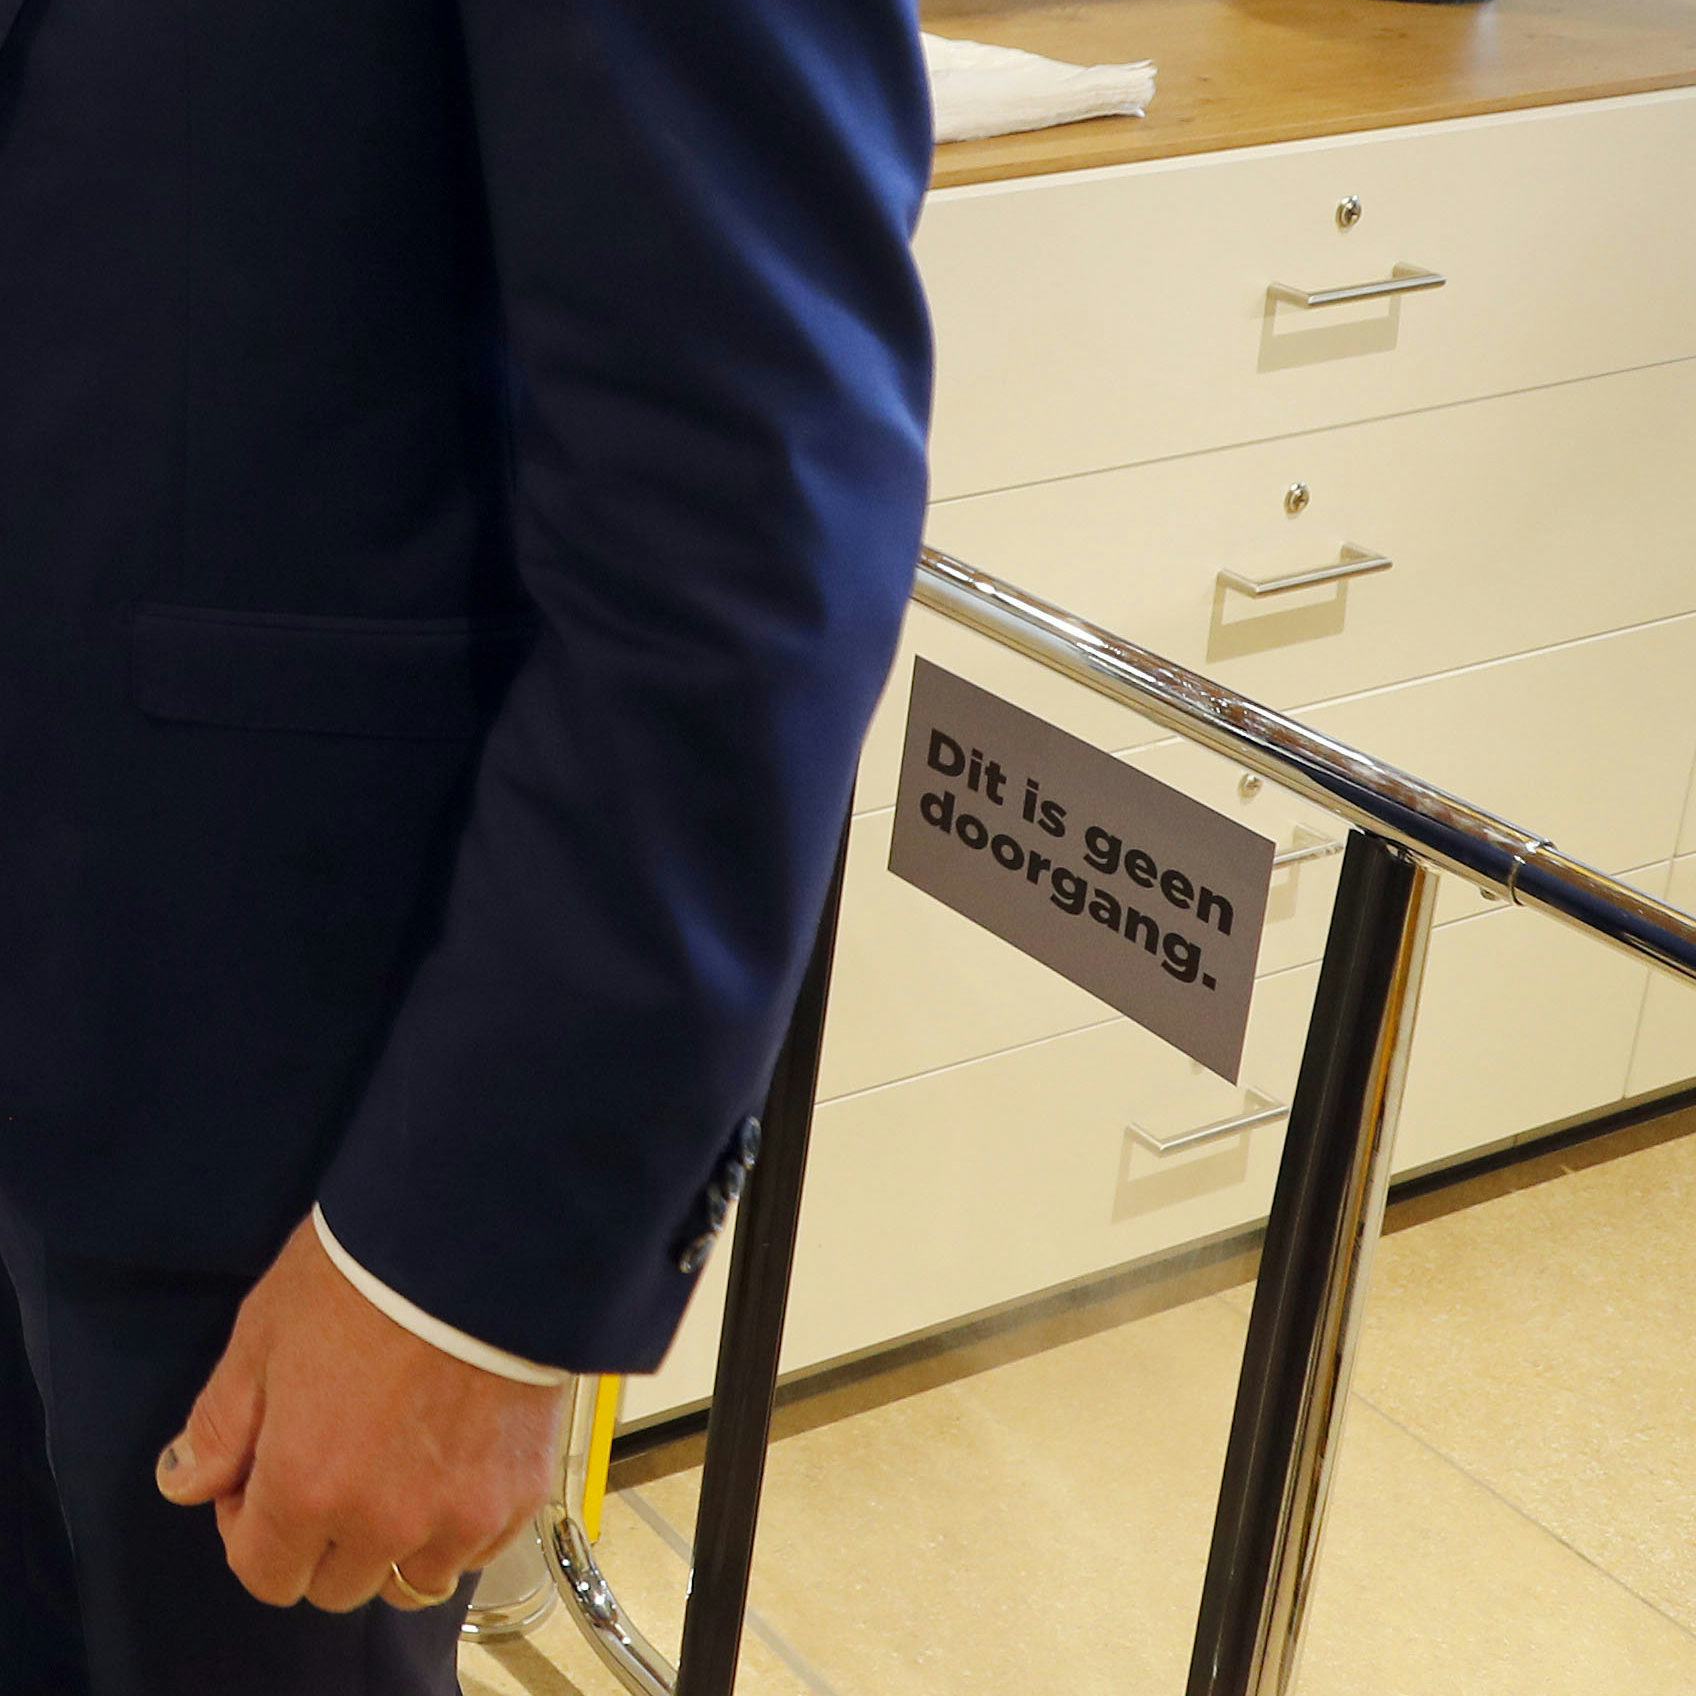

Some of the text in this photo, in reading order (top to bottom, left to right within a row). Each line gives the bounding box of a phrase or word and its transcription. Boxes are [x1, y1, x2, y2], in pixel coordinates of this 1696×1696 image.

[919, 790, 1217, 991] doorgang.
[926, 727, 1234, 937] Dit is geen
